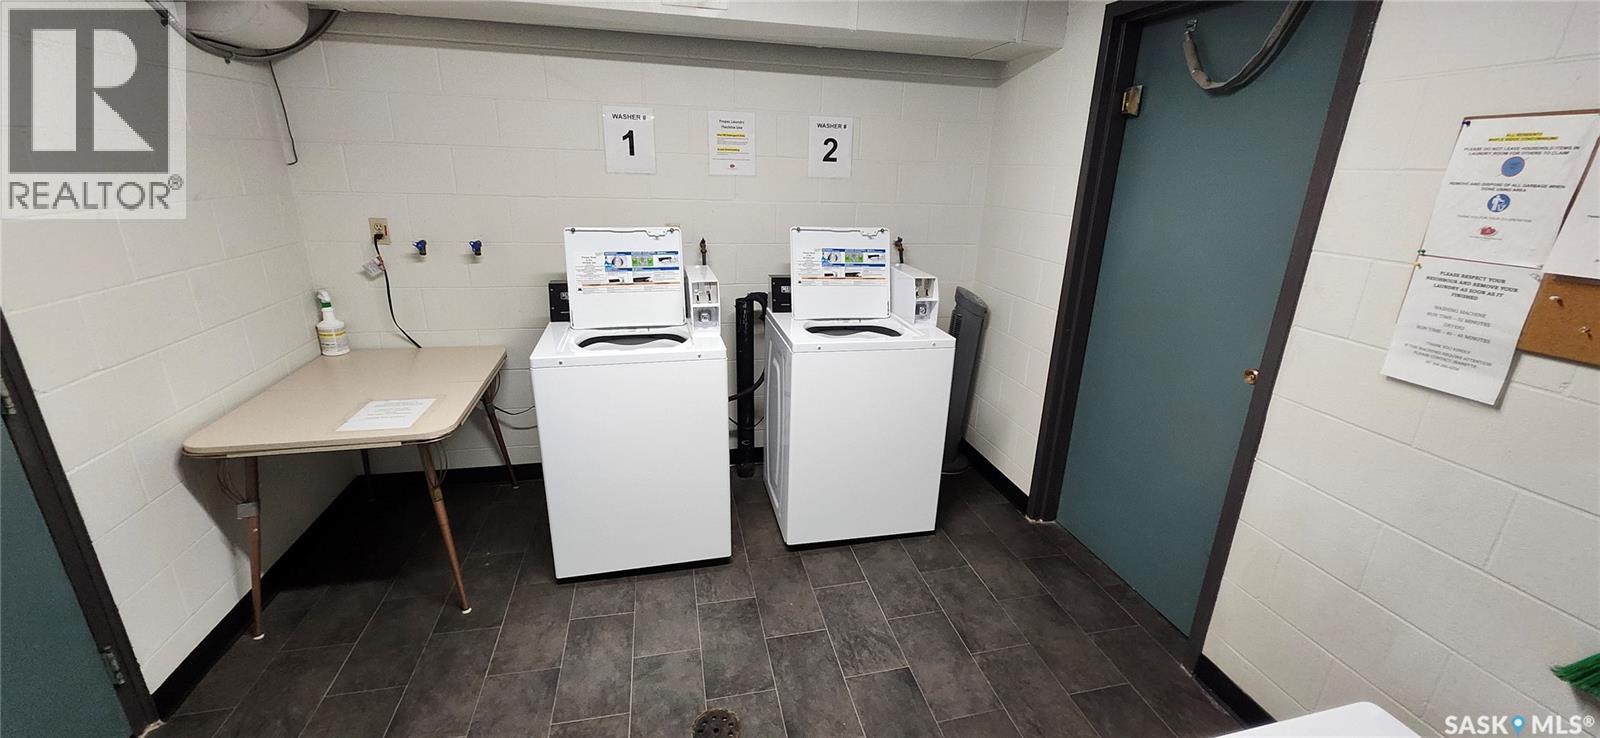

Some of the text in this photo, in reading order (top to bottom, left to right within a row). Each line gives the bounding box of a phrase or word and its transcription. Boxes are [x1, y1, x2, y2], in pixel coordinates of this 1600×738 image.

[622, 129, 635, 156] 1
[822, 137, 838, 162] 2
[1433, 283, 1459, 291] LAUNDRY
[1472, 282, 1499, 290] REMOVE
[1434, 305, 1487, 319] WASHING MACHINE
[1464, 318, 1491, 328] MINUTES
[1428, 326, 1442, 334] TIME
[1464, 333, 1491, 344] MINUTES
